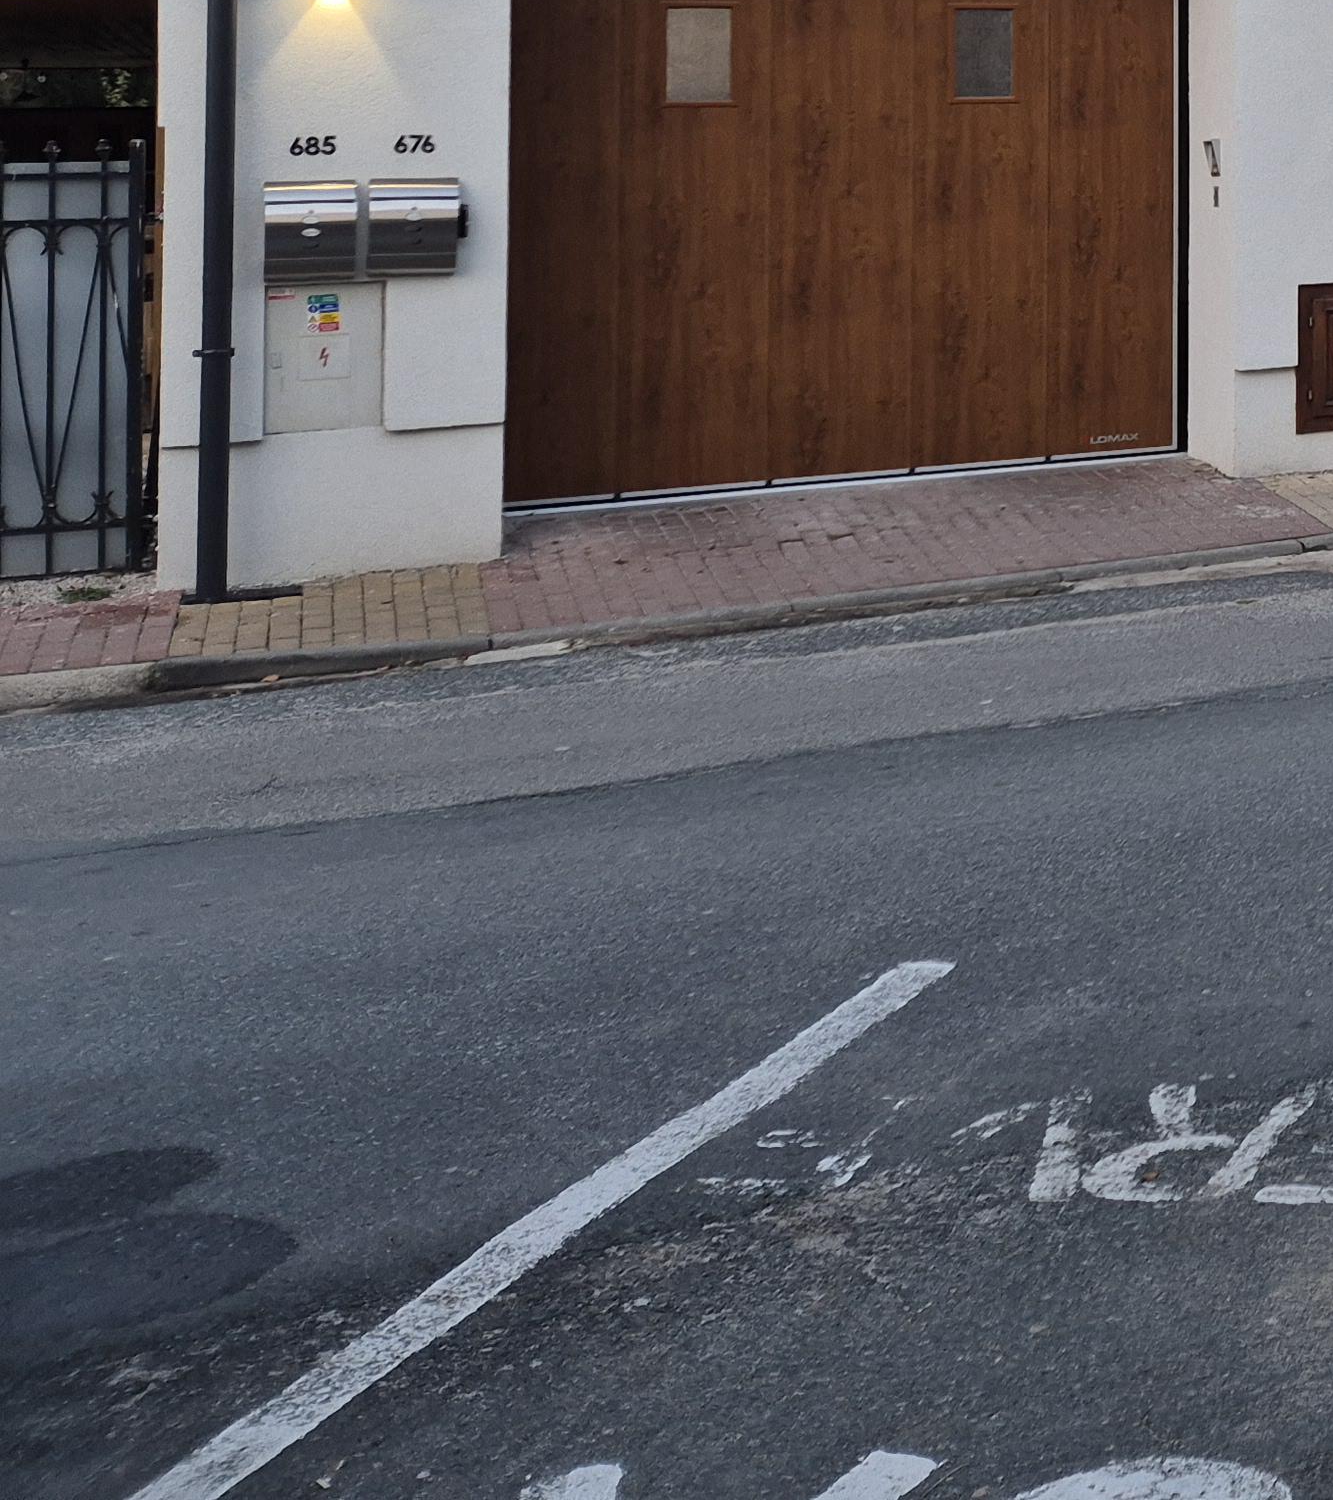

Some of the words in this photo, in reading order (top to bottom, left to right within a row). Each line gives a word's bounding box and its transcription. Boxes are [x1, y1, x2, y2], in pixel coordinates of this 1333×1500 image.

[290, 135, 337, 156] 685
[393, 134, 436, 154] 676
[1090, 433, 1139, 444] LOMAX
